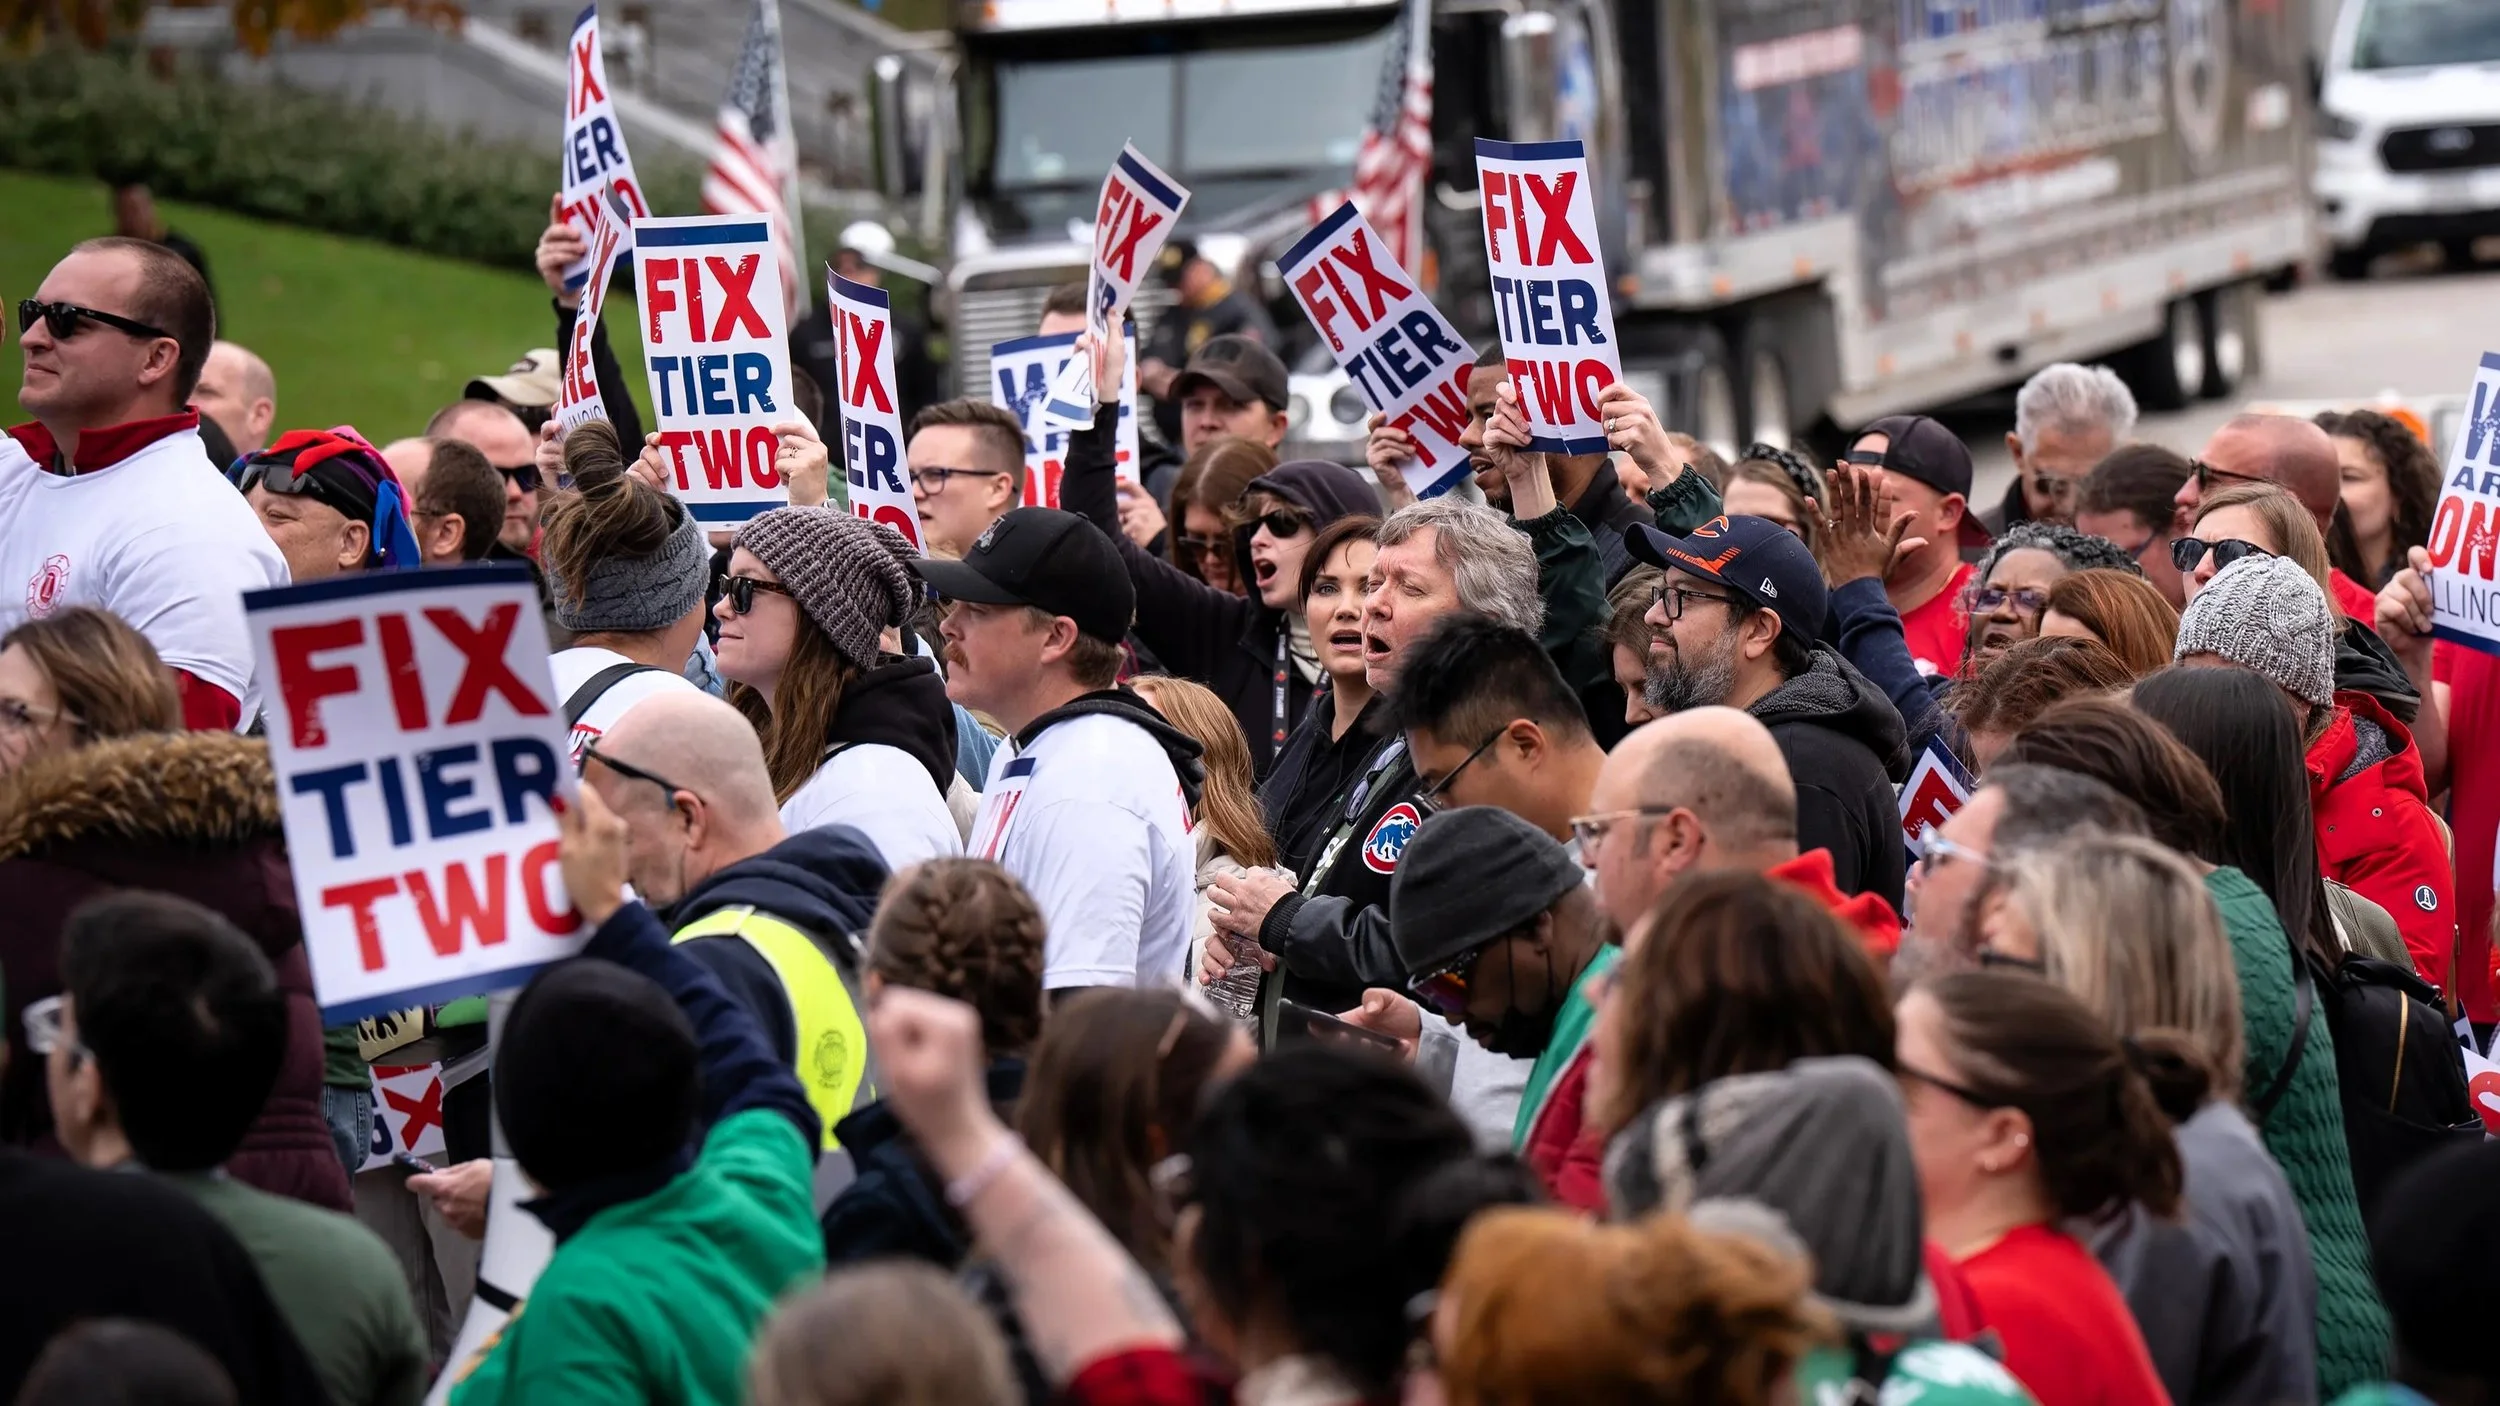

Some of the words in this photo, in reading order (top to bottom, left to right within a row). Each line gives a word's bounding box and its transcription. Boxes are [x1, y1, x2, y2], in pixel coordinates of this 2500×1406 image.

[570, 30, 604, 120] IX
[565, 116, 624, 188] IER
[1095, 174, 1164, 284] FIX
[1482, 170, 1594, 267] FIX
[644, 253, 773, 345] FIX
[1294, 226, 1412, 354] FIX
[1492, 276, 1607, 346] TIER
[650, 352, 777, 417] TIER
[1344, 309, 1462, 411] TIER
[1505, 358, 1615, 426] TWO
[660, 426, 781, 491] TWO
[842, 412, 906, 494] ER
[2427, 495, 2500, 582] ON
[270, 601, 553, 750] FIX
[289, 734, 559, 860] TIER
[321, 839, 585, 974] TWO
